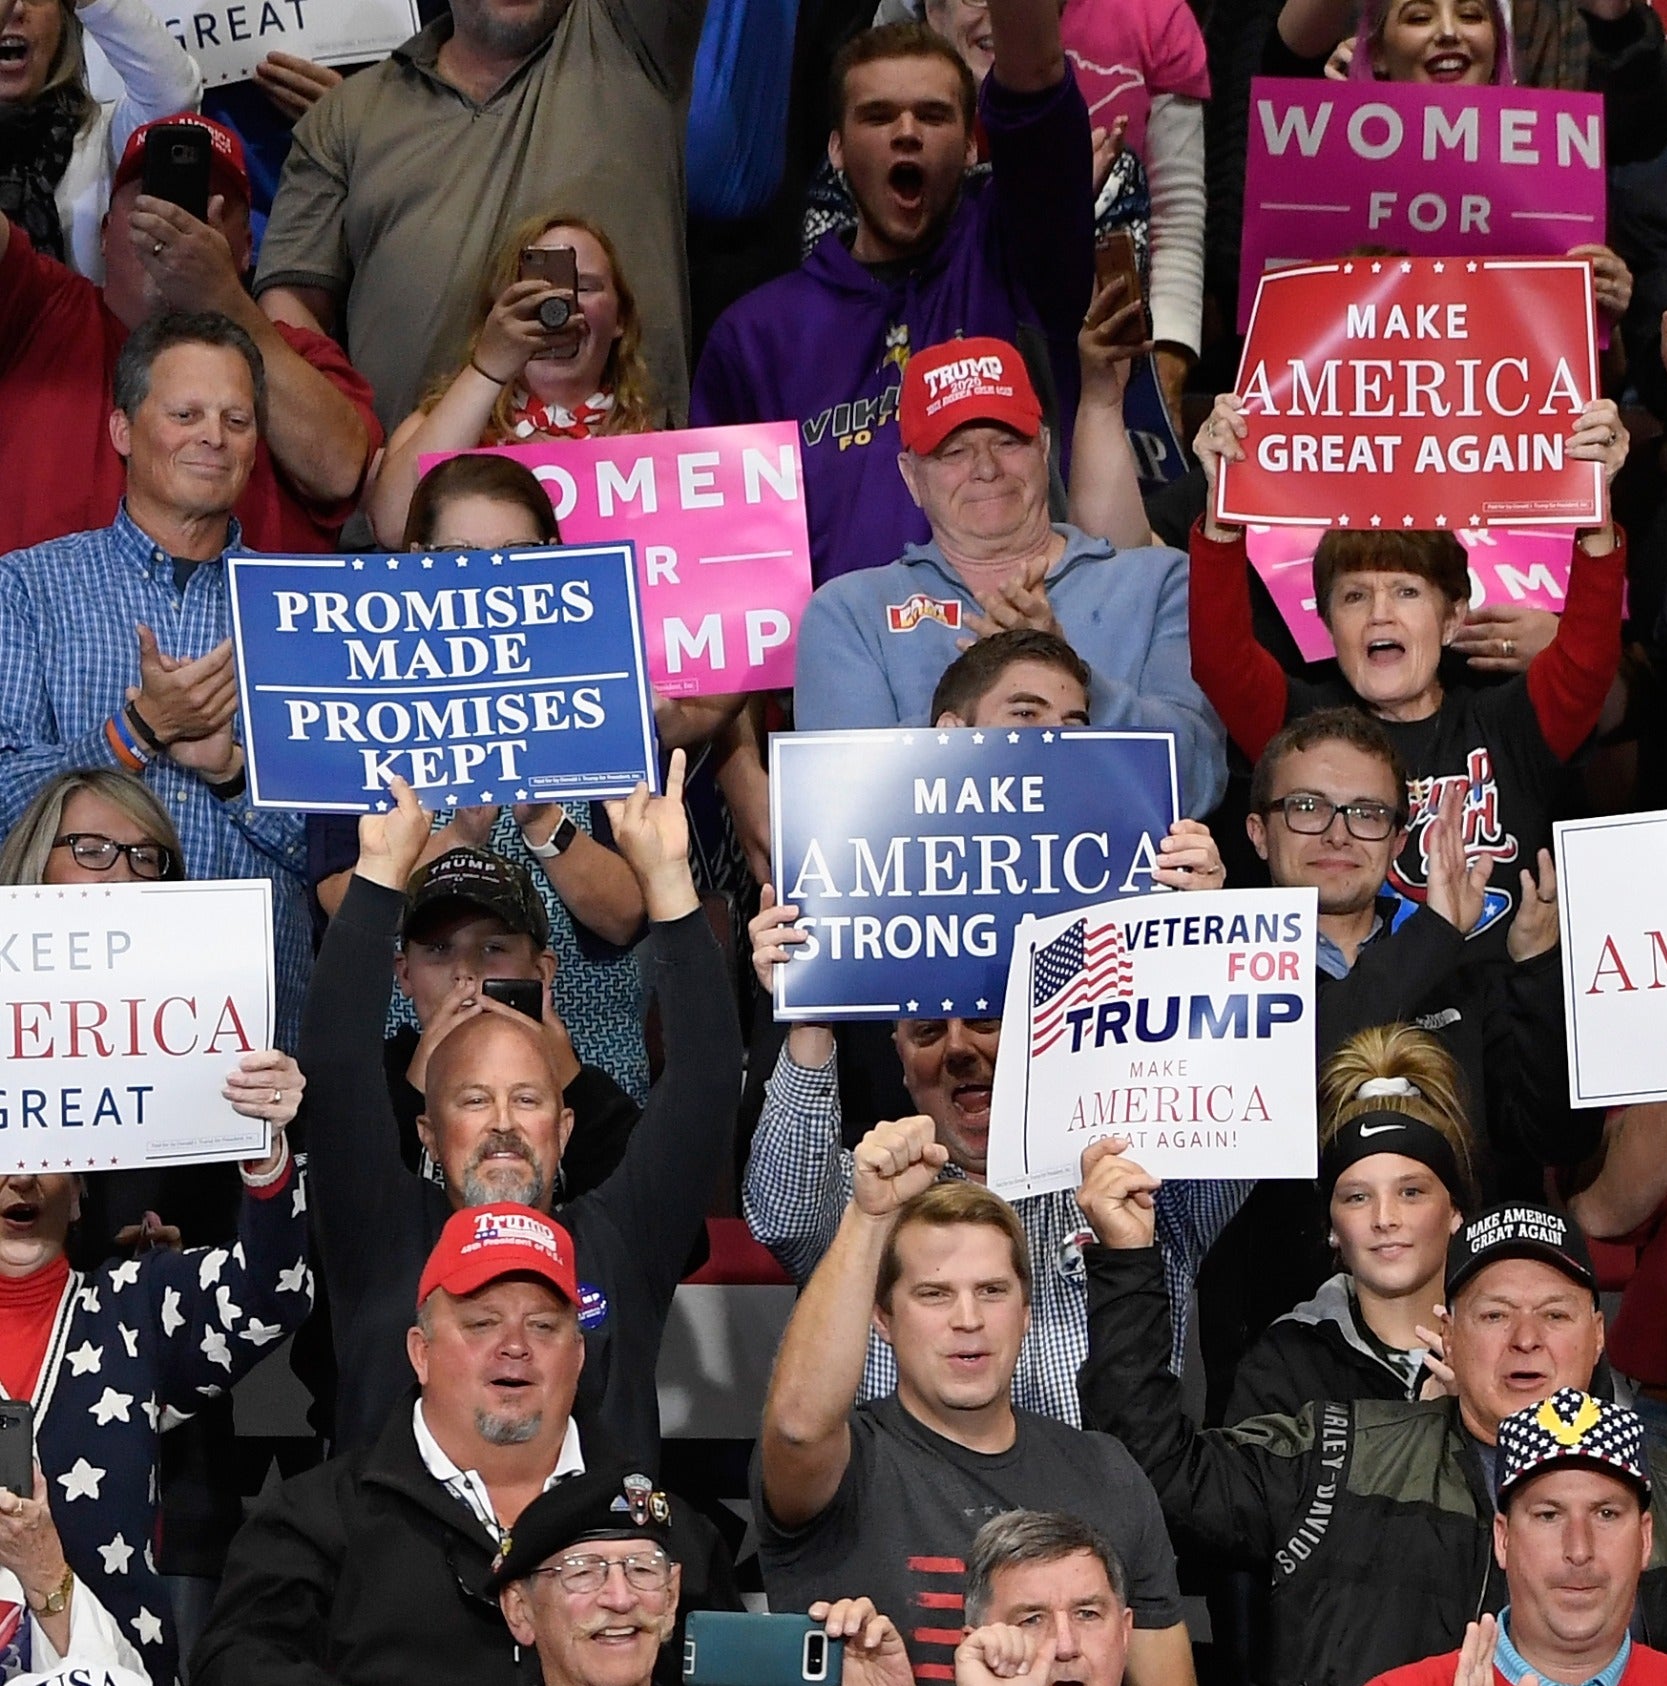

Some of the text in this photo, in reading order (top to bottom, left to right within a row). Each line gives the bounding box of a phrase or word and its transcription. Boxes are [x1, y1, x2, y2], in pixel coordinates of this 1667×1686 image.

[1258, 100, 1602, 170] WOMEN
[1367, 192, 1493, 234] FOR
[1346, 304, 1469, 341] MAKE
[923, 356, 1004, 397] TRUMP
[1240, 357, 1585, 418] AMERICA
[1257, 434, 1564, 473] GREAT AGAIN
[274, 581, 595, 635] PROMISES
[346, 634, 532, 682] MADE
[285, 687, 606, 743] PROMISES
[359, 739, 529, 792] KEPT
[913, 777, 1045, 814] MAKE
[431, 859, 496, 874] TRUMP
[789, 834, 1178, 899] AMERICA
[794, 914, 998, 963] STRONG
[1123, 914, 1303, 952] VETERANS
[1227, 954, 1300, 982] FOR
[4, 994, 256, 1062] ERICA
[1066, 994, 1304, 1054] TRUMP
[1130, 1061, 1188, 1079] MAKE
[1068, 1085, 1272, 1132] AMERICA
[1158, 1129, 1237, 1148] AGAIN!
[474, 1213, 556, 1244] Trump
[1466, 1209, 1567, 1241] MAKE AMERICA
[1471, 1224, 1563, 1253] GREAT AGAIN
